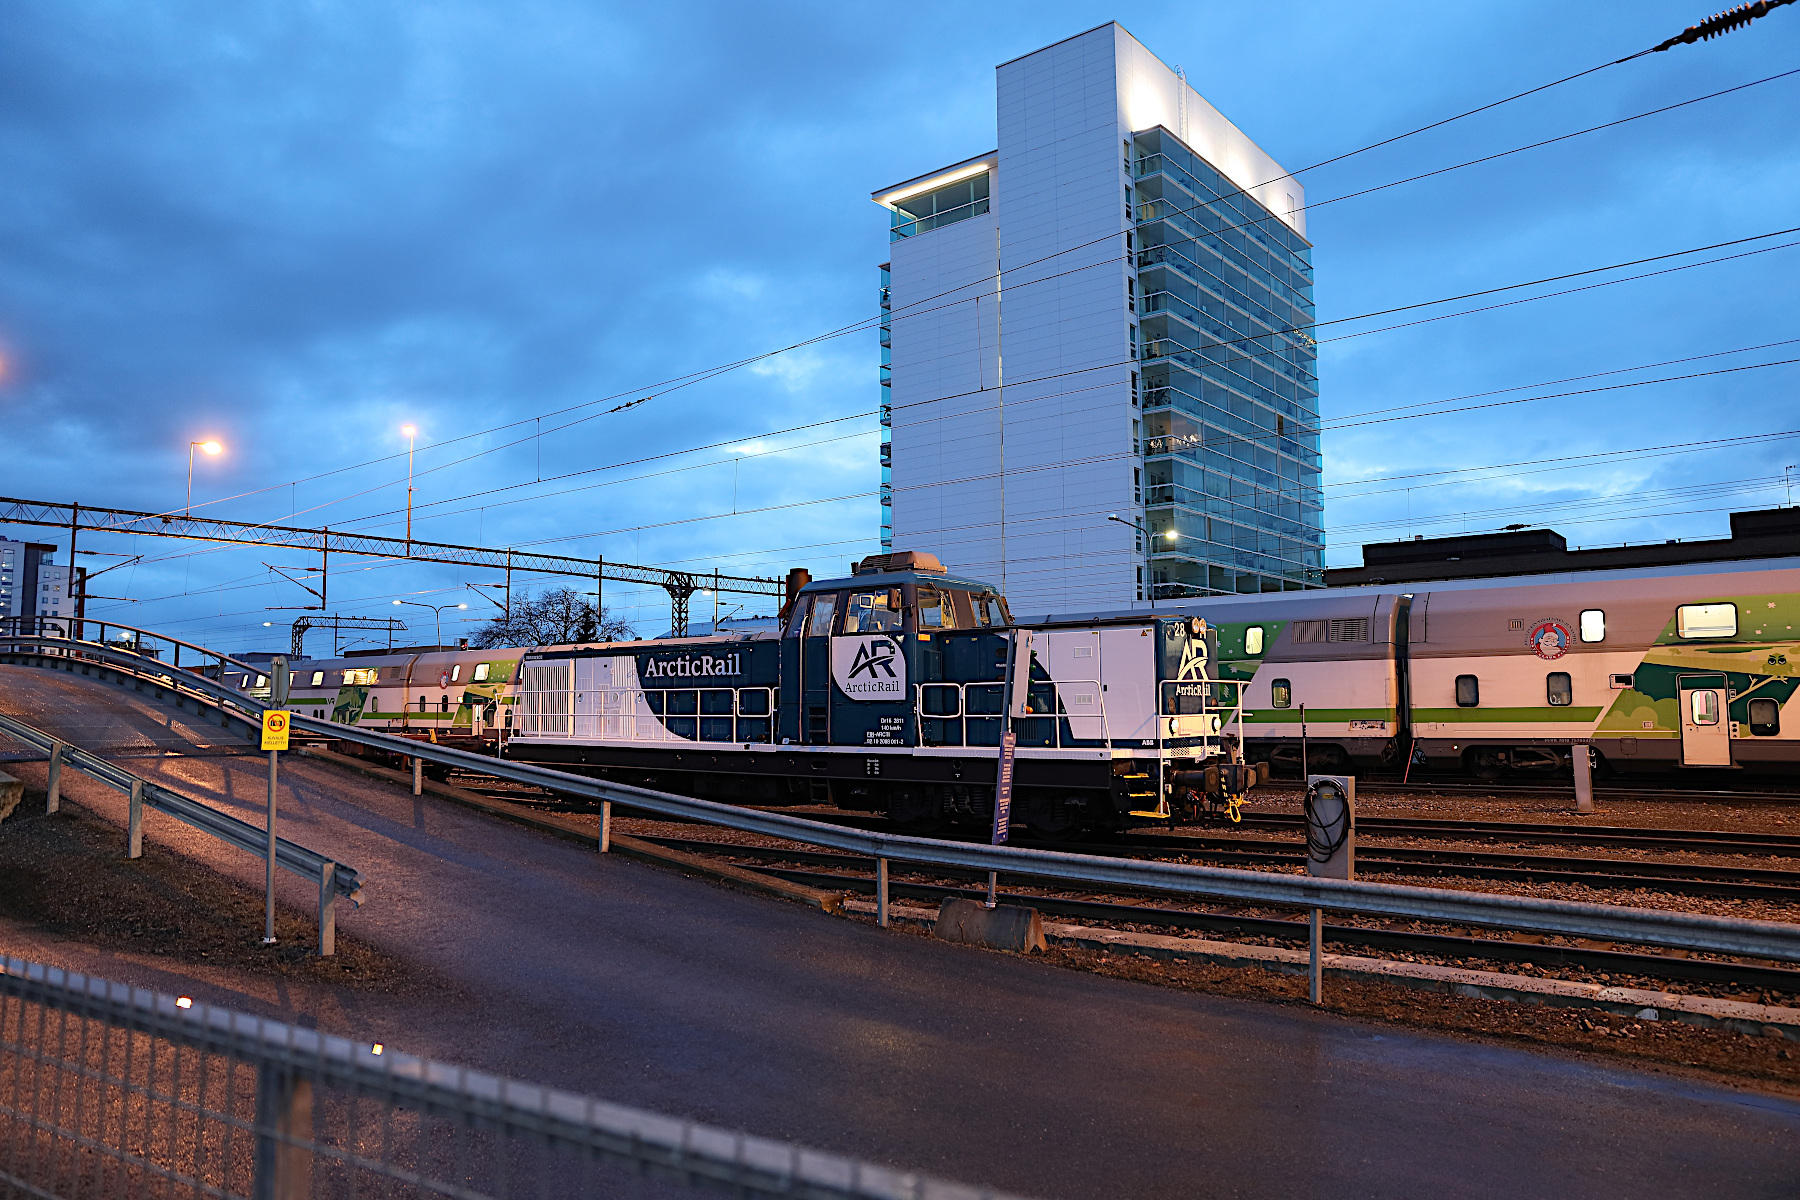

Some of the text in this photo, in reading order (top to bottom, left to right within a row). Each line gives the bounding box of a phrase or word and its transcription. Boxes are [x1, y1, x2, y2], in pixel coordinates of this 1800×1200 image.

[645, 653, 741, 677] ArcticRail
[844, 680, 900, 693] ArcticRail
[1175, 683, 1211, 697] ArcticRil
